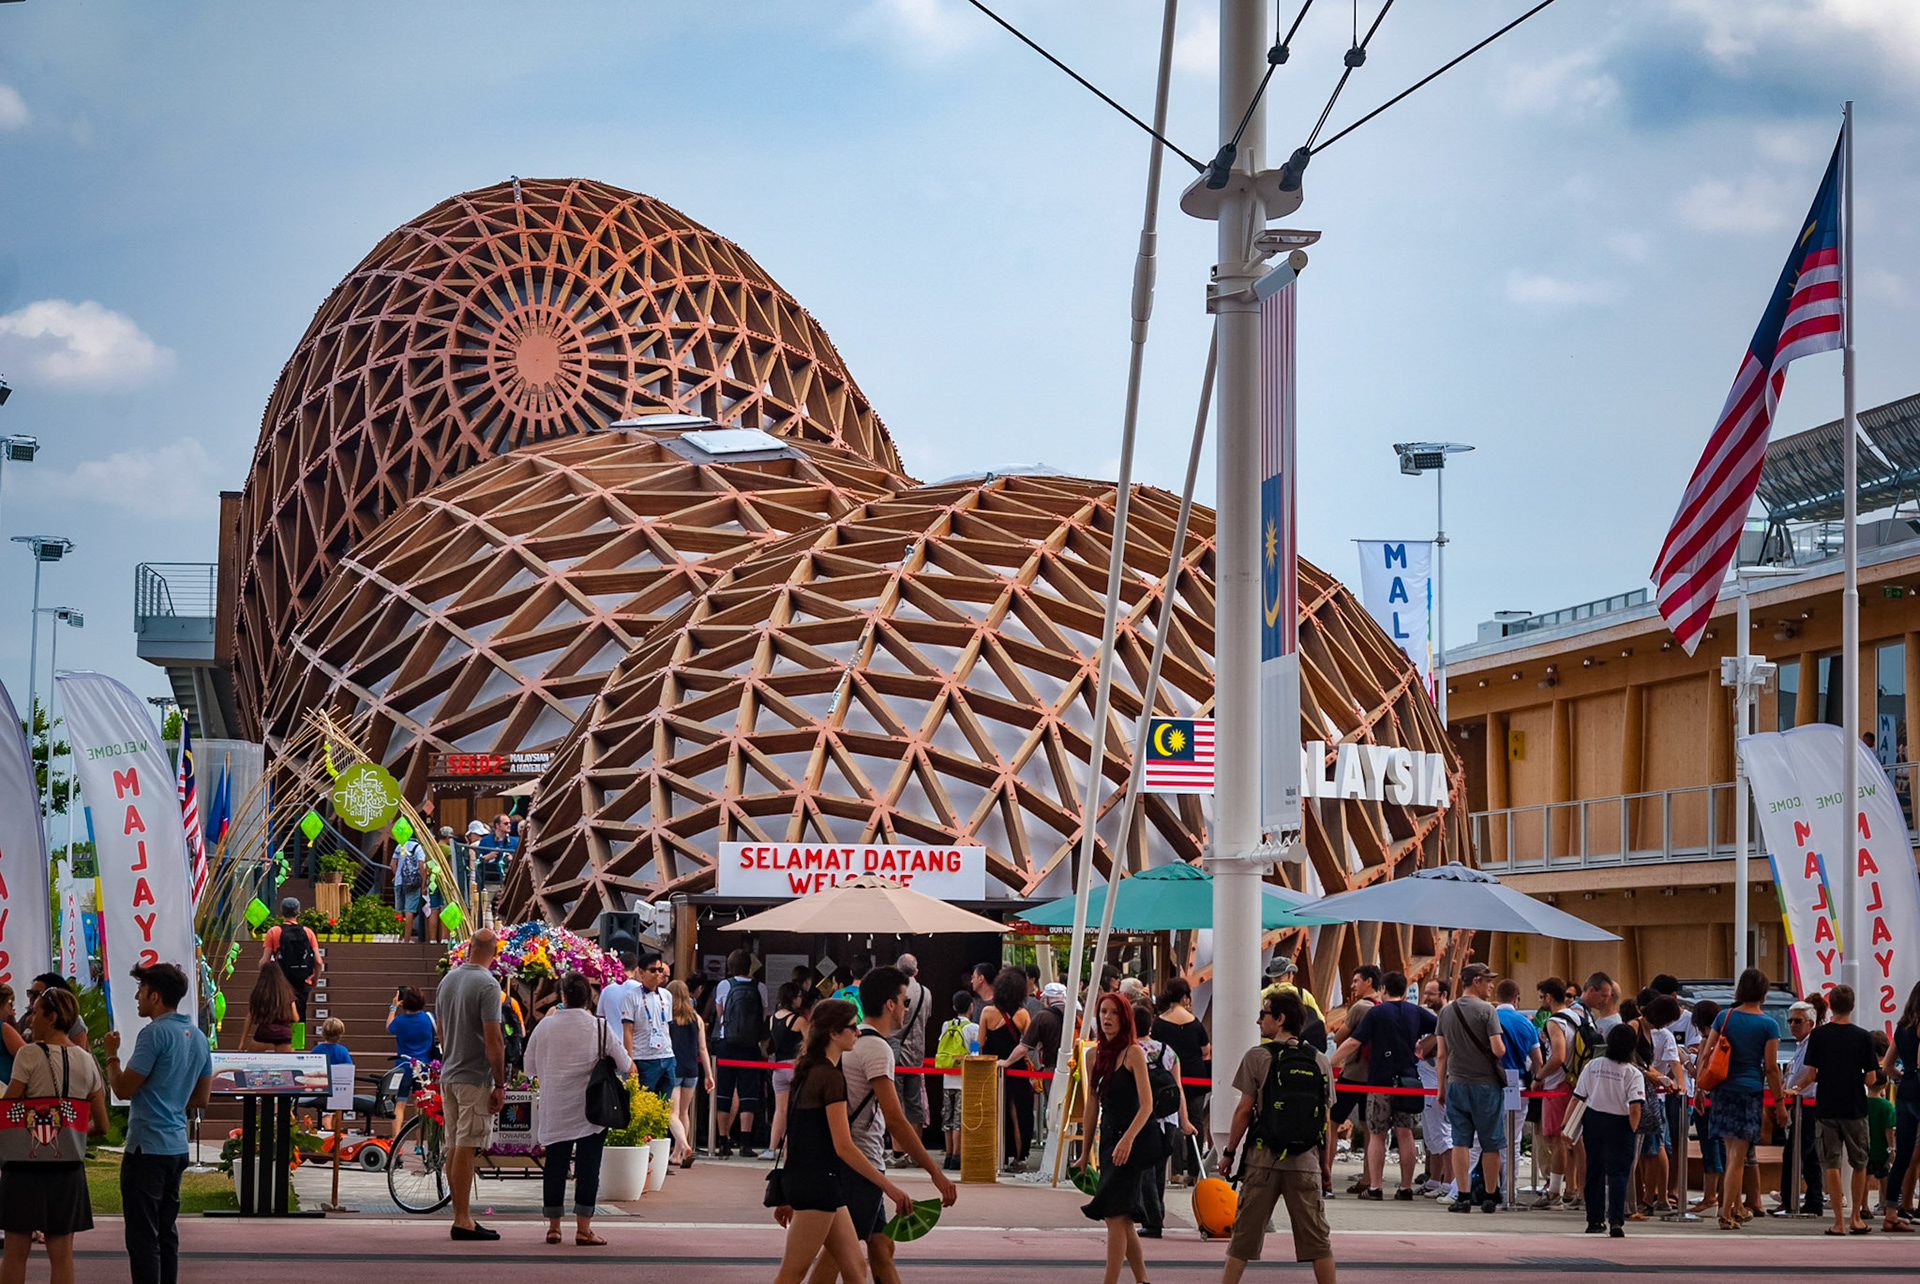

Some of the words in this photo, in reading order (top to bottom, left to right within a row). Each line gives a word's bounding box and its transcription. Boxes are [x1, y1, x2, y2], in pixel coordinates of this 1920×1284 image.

[1383, 543, 1410, 656] MAL
[448, 754, 490, 774] SEED
[1300, 740, 1450, 808] LAYSIA
[740, 847, 855, 870] SELAMAT
[864, 849, 962, 873] DATANG
[788, 872, 914, 895] WELE
